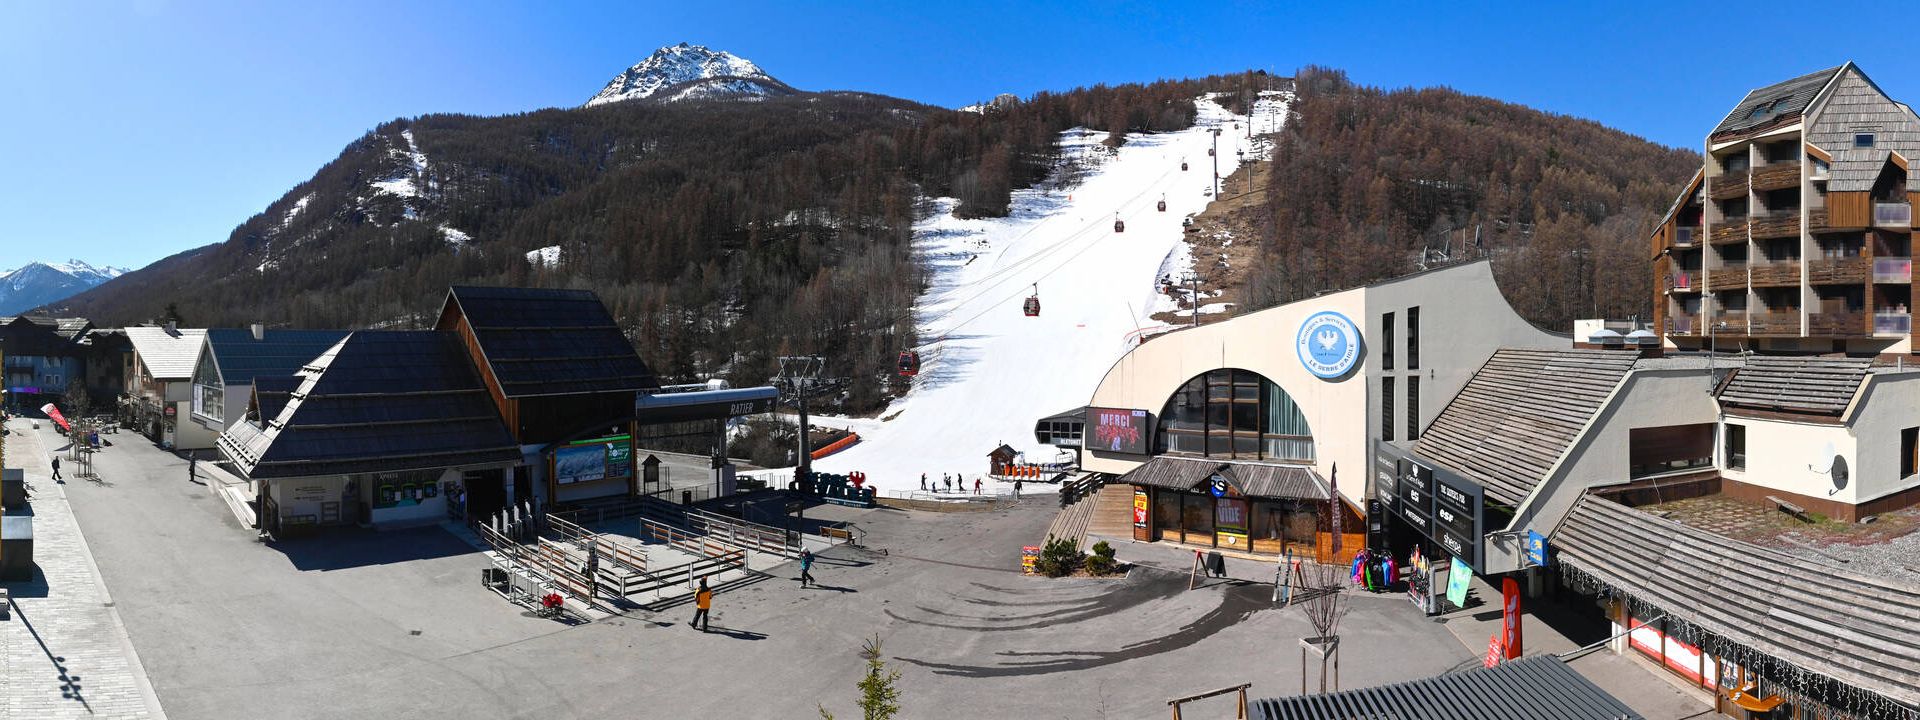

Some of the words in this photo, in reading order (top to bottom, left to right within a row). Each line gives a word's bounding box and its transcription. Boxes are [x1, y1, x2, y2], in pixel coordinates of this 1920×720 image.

[730, 402, 754, 415] RATIER
[1100, 413, 1130, 427] MERCI
[1217, 506, 1241, 523] VIDE
[1443, 532, 1462, 553] sherpa
